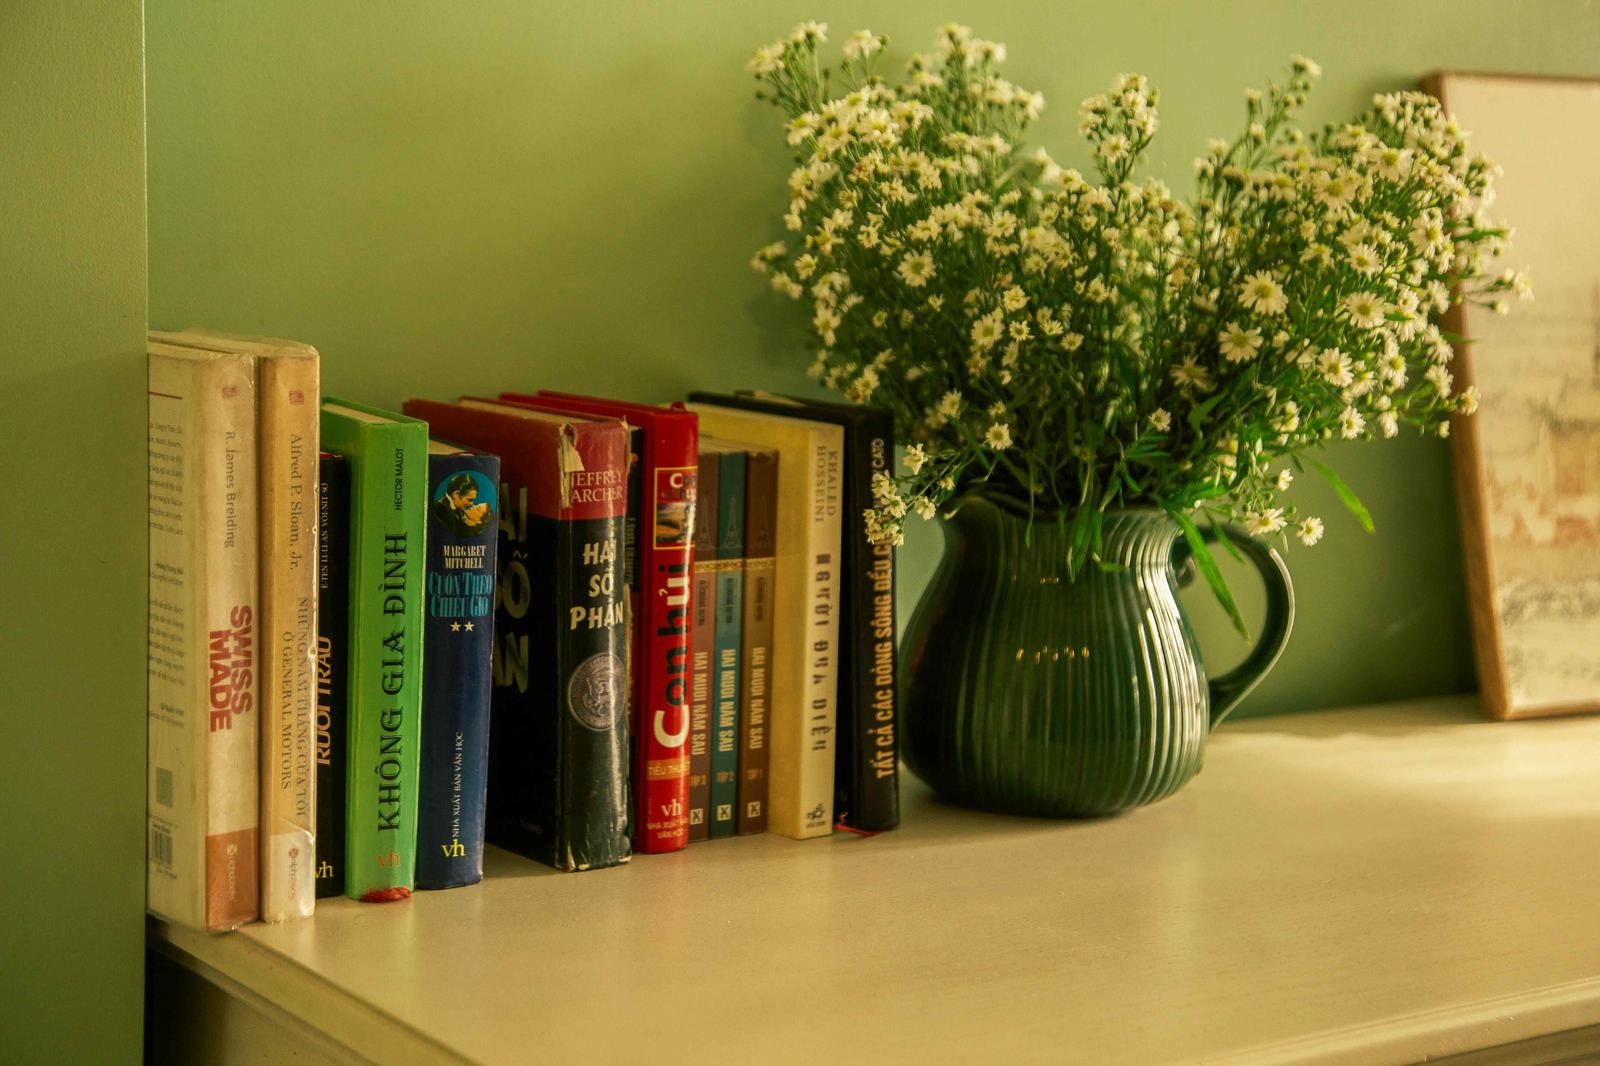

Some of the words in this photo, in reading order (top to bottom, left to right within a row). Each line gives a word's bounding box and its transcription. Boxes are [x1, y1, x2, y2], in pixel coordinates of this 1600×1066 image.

[225, 431, 236, 445] R.
[225, 447, 240, 490] James
[290, 434, 303, 479] Alfred
[396, 447, 405, 477] MALOT
[291, 484, 303, 496] P.
[395, 479, 404, 511] HECTOR
[570, 485, 624, 503] ARCHER
[815, 445, 827, 523] HOSSEINI
[827, 450, 838, 517] KHALED
[224, 492, 237, 549] Breiding
[498, 481, 528, 543] AI
[290, 551, 303, 570] Jr.
[443, 545, 486, 557] MARGARET
[445, 557, 484, 569] MITCHELL
[583, 539, 617, 566] HAI
[378, 531, 408, 616] ĐÌNH
[870, 594, 893, 639] SÔNG
[230, 604, 253, 715] SWISS
[381, 625, 405, 696] GIA
[694, 652, 707, 670] HAI
[721, 648, 736, 667] HAI
[752, 647, 766, 665] HAI
[869, 641, 893, 686] DÒNG
[209, 629, 233, 733] MADE
[282, 646, 293, 720] GENERAL
[653, 647, 690, 749] Con
[872, 688, 894, 721] CÁC
[691, 733, 706, 755] SAU
[718, 730, 734, 752] SAU
[749, 727, 763, 749] SAU
[867, 724, 894, 747] CẢ
[281, 725, 293, 790] MOTORS
[374, 706, 404, 833] KHÔNG
[869, 750, 894, 779] TẤT
[661, 798, 683, 817] vh
[451, 818, 460, 838] NHÀ
[376, 848, 401, 869] vh
[441, 838, 466, 857] vh
[313, 860, 335, 880] vh
